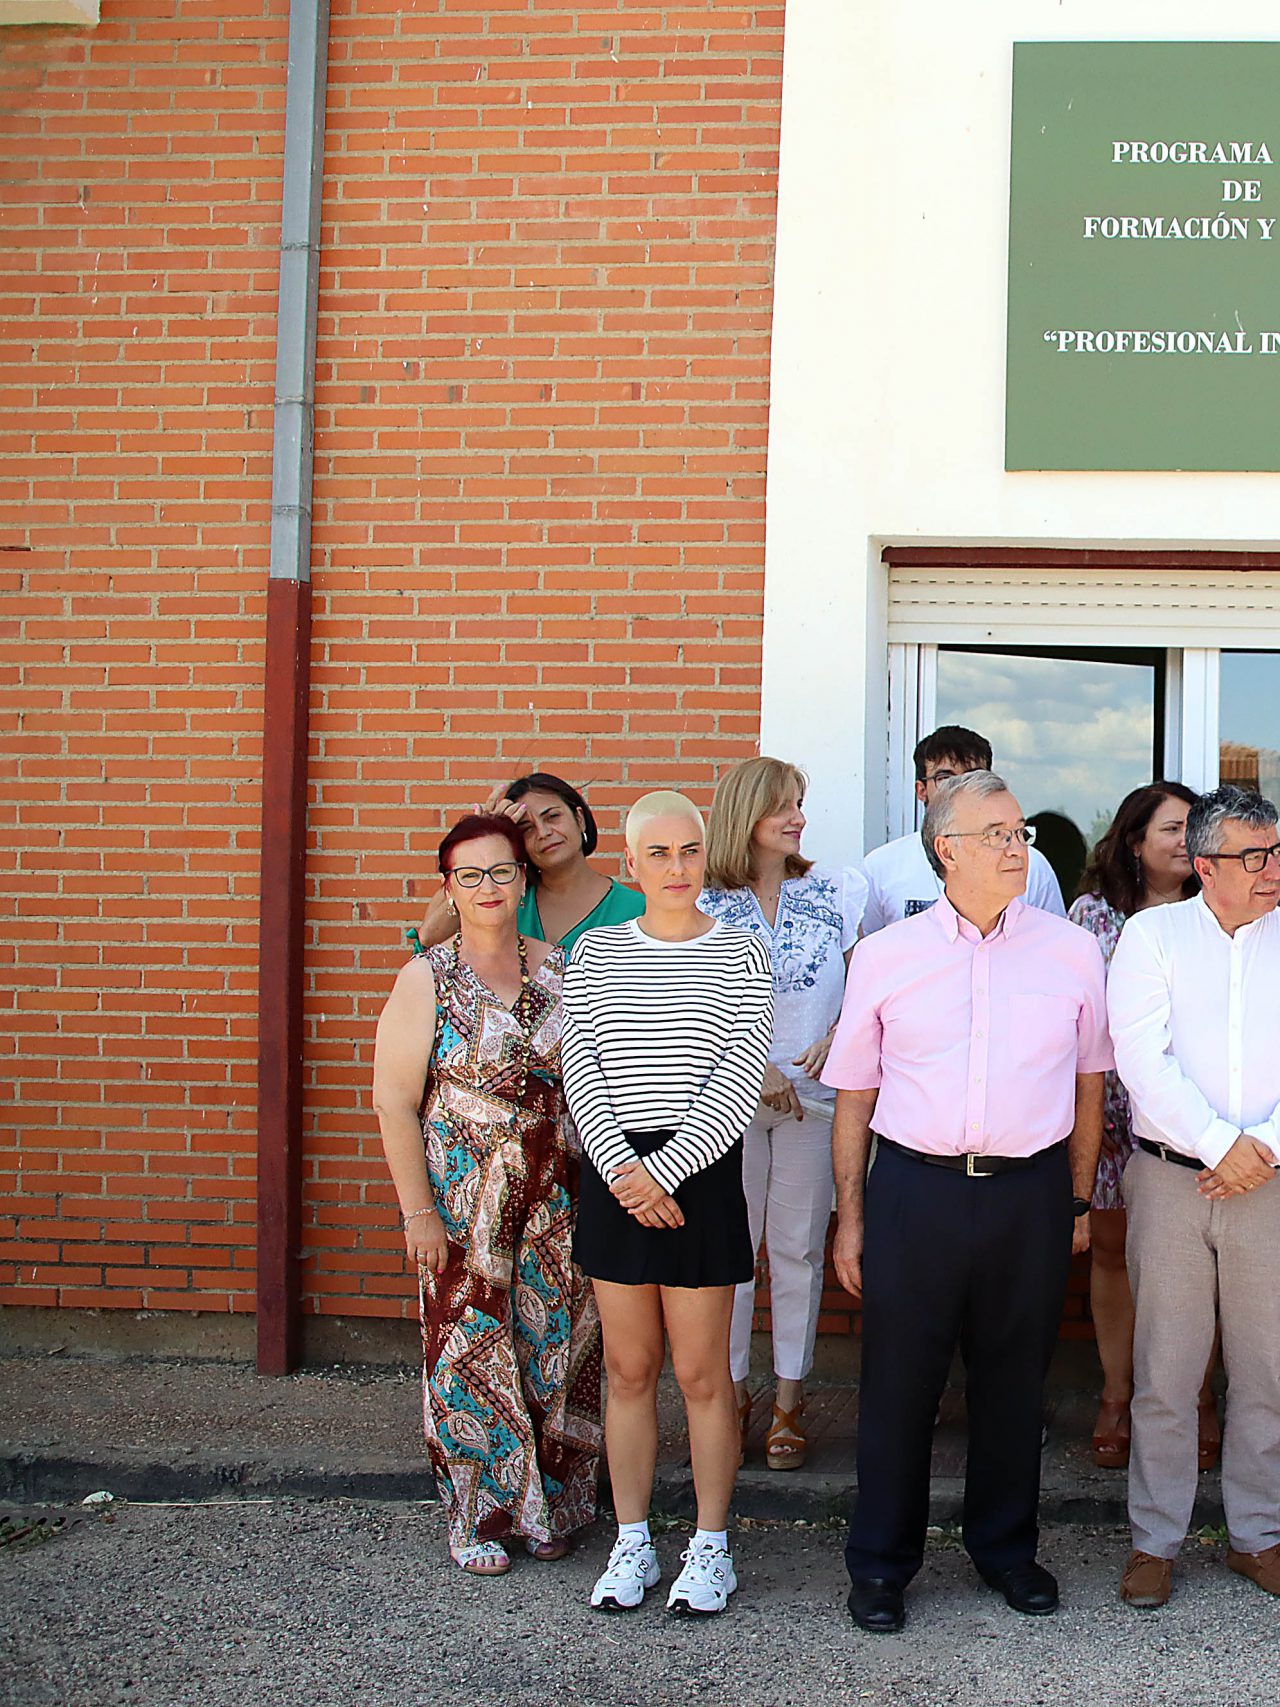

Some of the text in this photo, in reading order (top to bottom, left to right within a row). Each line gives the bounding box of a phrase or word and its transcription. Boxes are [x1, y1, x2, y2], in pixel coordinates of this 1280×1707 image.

[1111, 142, 1274, 164] PROGRAMA
[1221, 180, 1262, 202] DE
[1083, 212, 1249, 240] FORMACIÓN
[1257, 218, 1277, 240] Y
